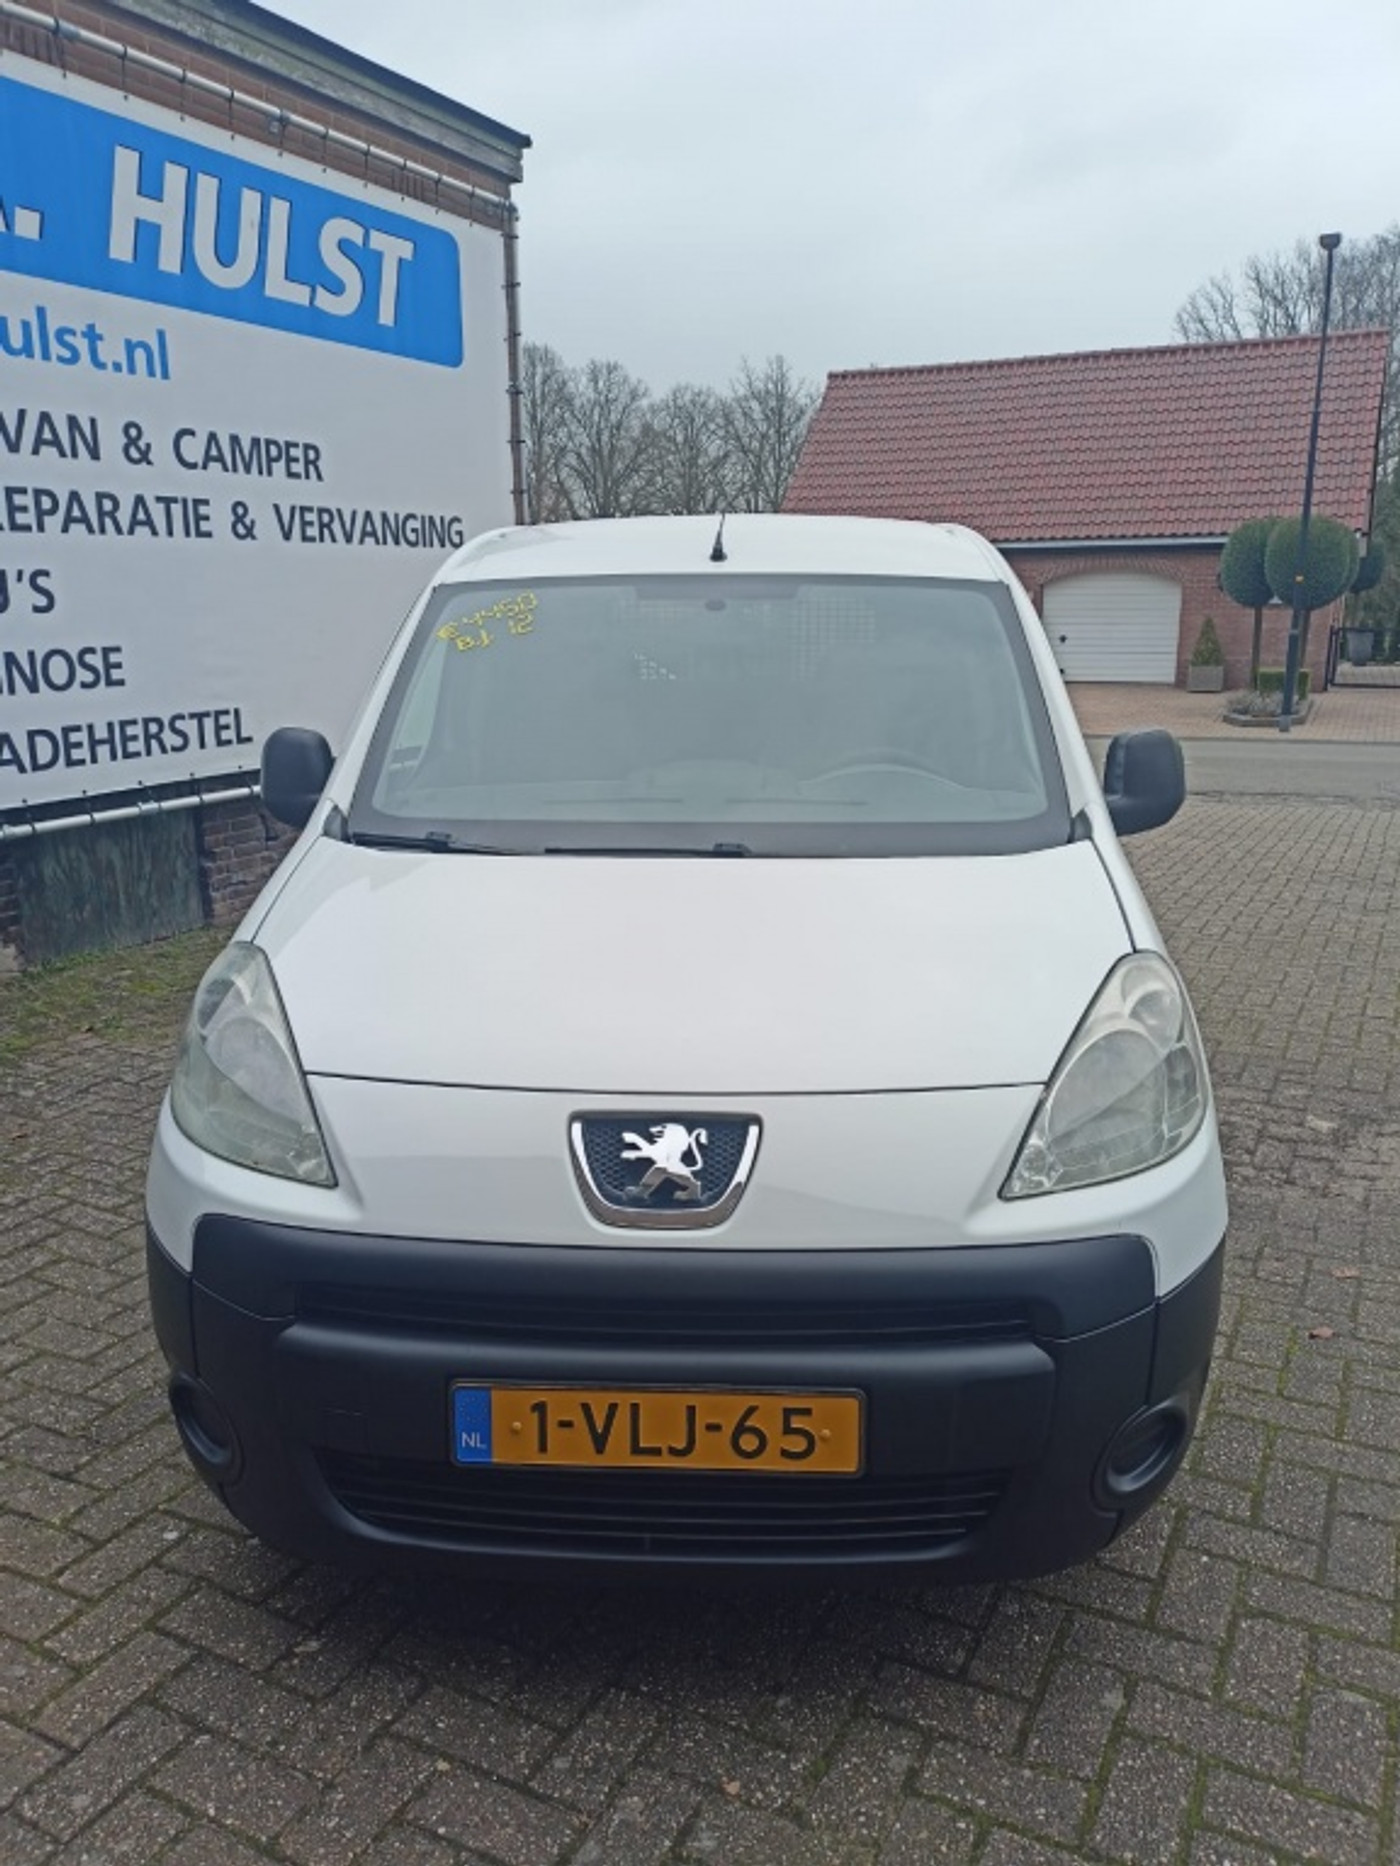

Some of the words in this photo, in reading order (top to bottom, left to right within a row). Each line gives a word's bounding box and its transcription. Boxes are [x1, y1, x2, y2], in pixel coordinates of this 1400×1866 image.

[109, 144, 415, 327] HULST
[0, 305, 171, 381] ulst.nl
[121, 420, 153, 466] &
[172, 427, 325, 482] CAMPER
[0, 486, 213, 540] EPARATIE
[230, 500, 257, 541] &
[272, 502, 465, 549] VERVANGING
[0, 646, 126, 696] NOSE
[0, 707, 253, 776] ADEHERSTEL
[461, 1431, 487, 1449] NL
[530, 1400, 816, 1460] 1-VLJ-65
